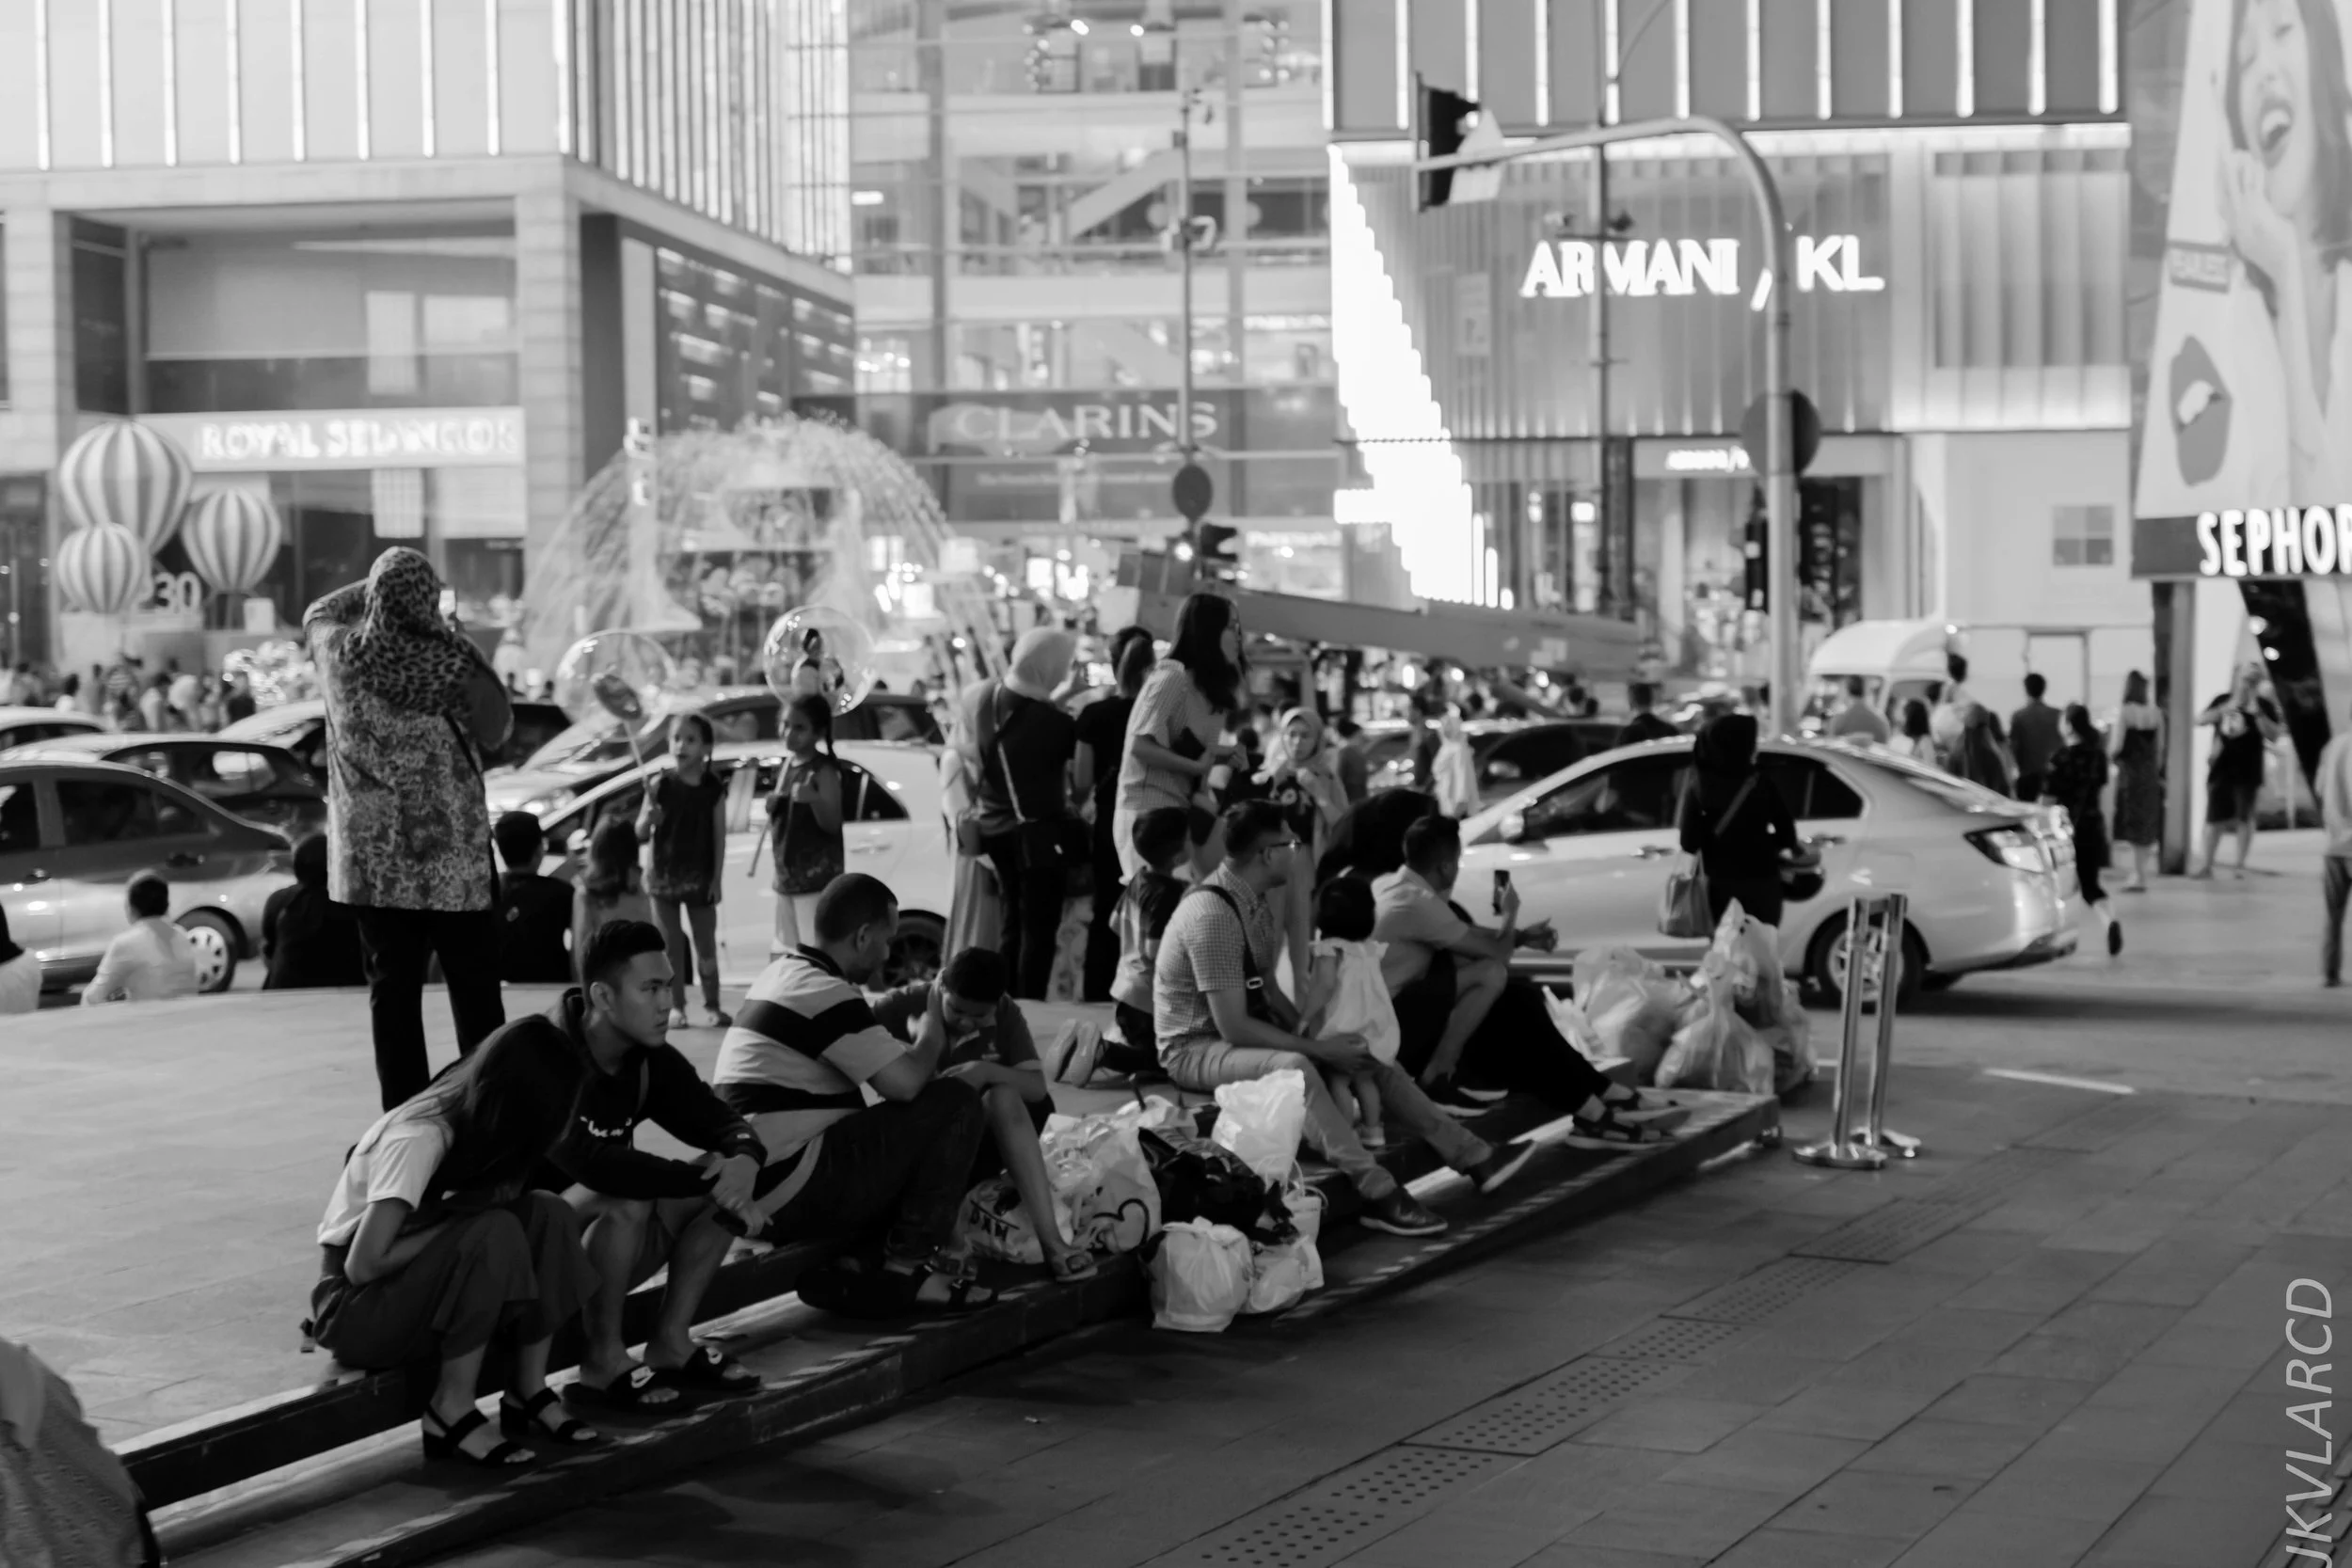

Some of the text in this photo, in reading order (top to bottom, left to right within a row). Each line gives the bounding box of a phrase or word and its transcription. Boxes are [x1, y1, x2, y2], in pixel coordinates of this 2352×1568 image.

[1519, 239, 1740, 297] ARMANI
[1796, 235, 1884, 292] KL
[956, 401, 1217, 438] CLARINS
[201, 421, 321, 459] ROYAL
